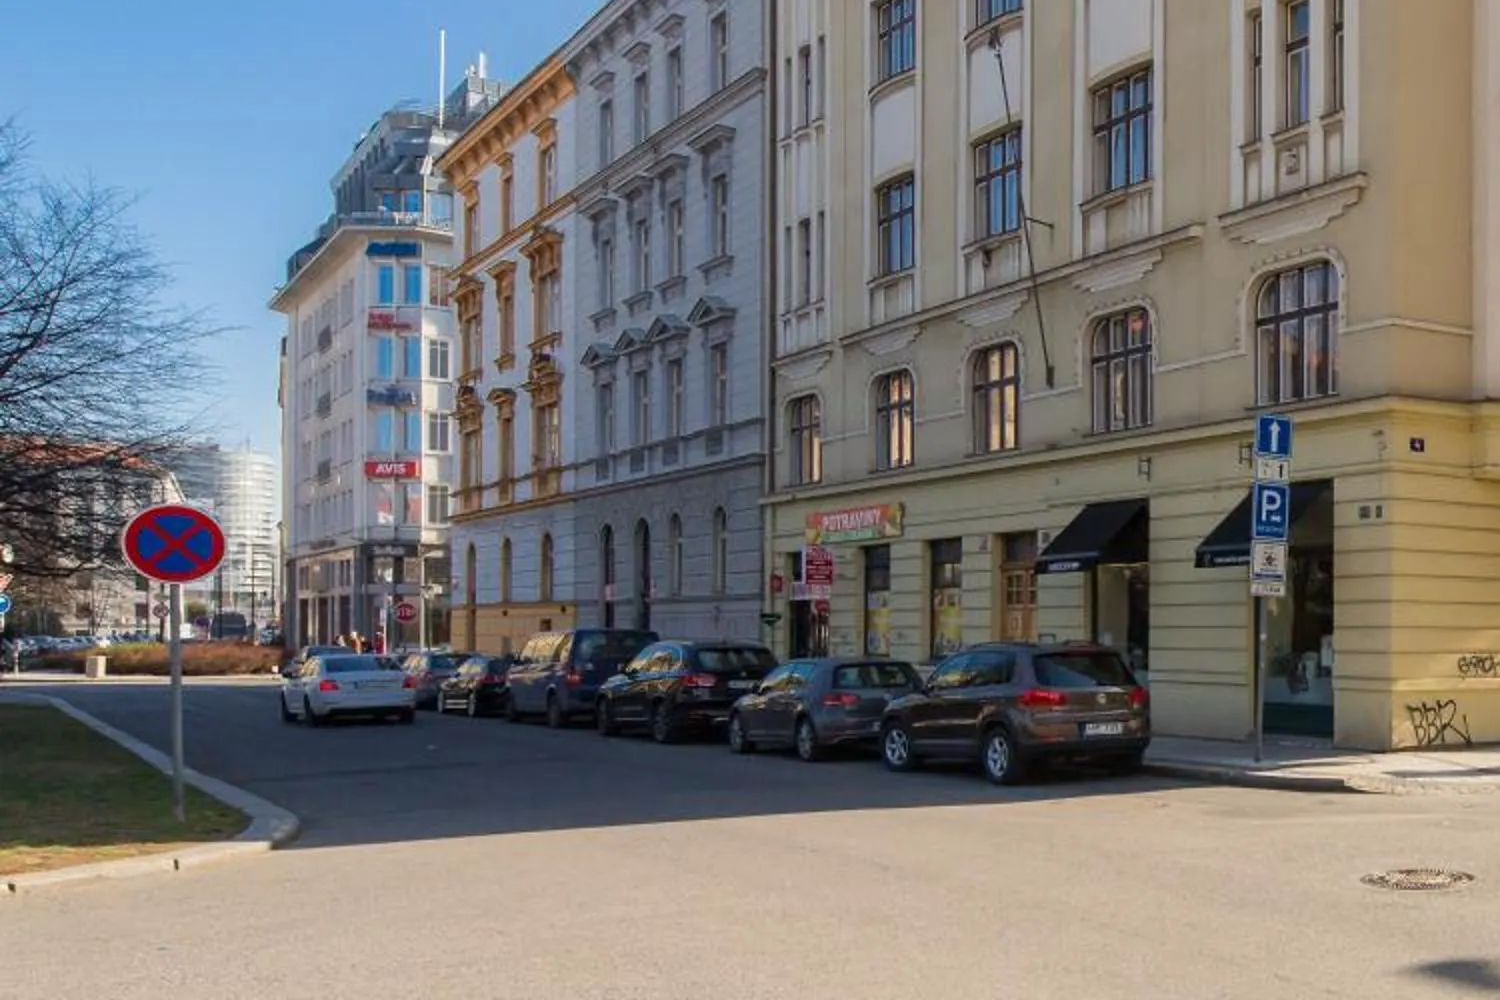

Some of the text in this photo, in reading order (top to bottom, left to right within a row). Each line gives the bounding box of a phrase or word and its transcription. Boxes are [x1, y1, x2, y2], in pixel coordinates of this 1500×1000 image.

[375, 463, 407, 475] AVIS
[1261, 489, 1281, 521] P
[821, 508, 881, 533] POTRAVINY
